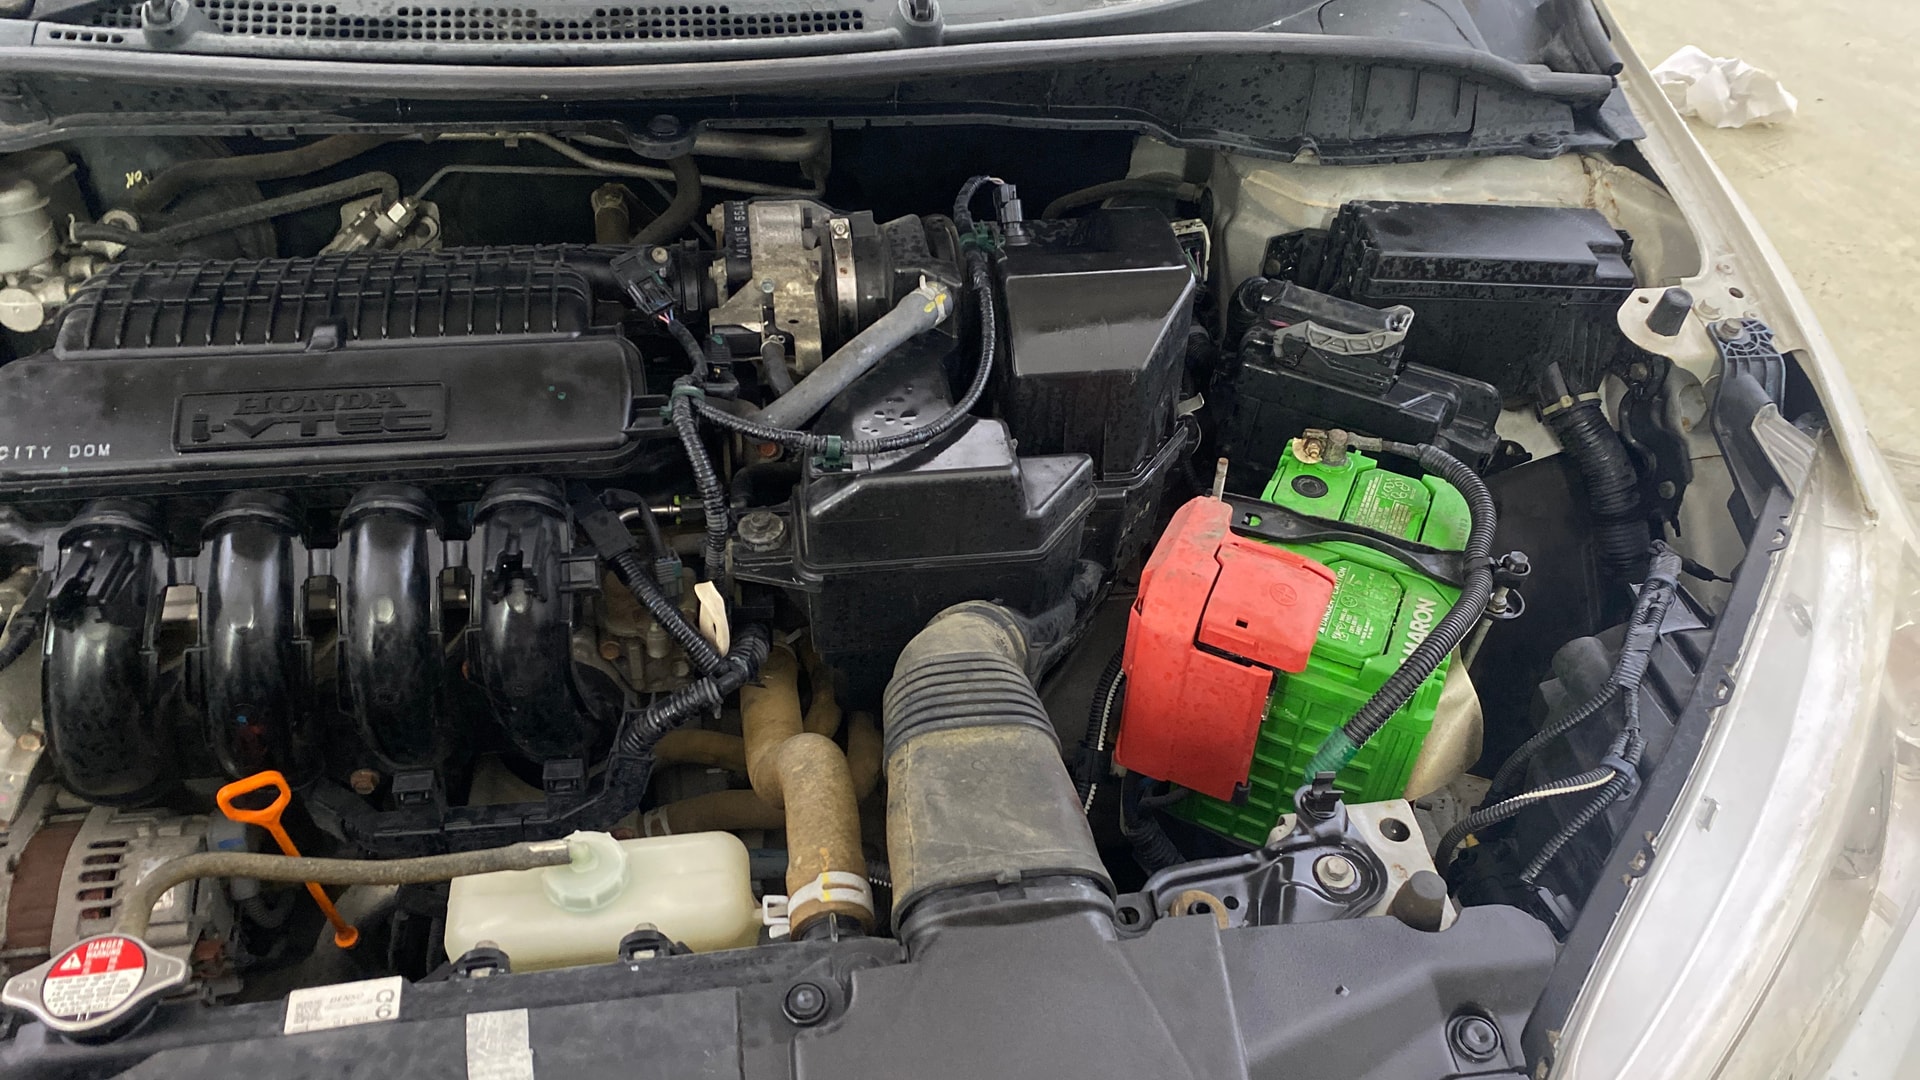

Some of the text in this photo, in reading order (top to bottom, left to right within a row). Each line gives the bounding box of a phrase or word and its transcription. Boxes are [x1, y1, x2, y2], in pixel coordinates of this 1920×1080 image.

[233, 390, 407, 416] HONDA
[0, 443, 111, 460] CITY DOM
[1400, 597, 1437, 664] MARON
[87, 939, 124, 951] DANGER
